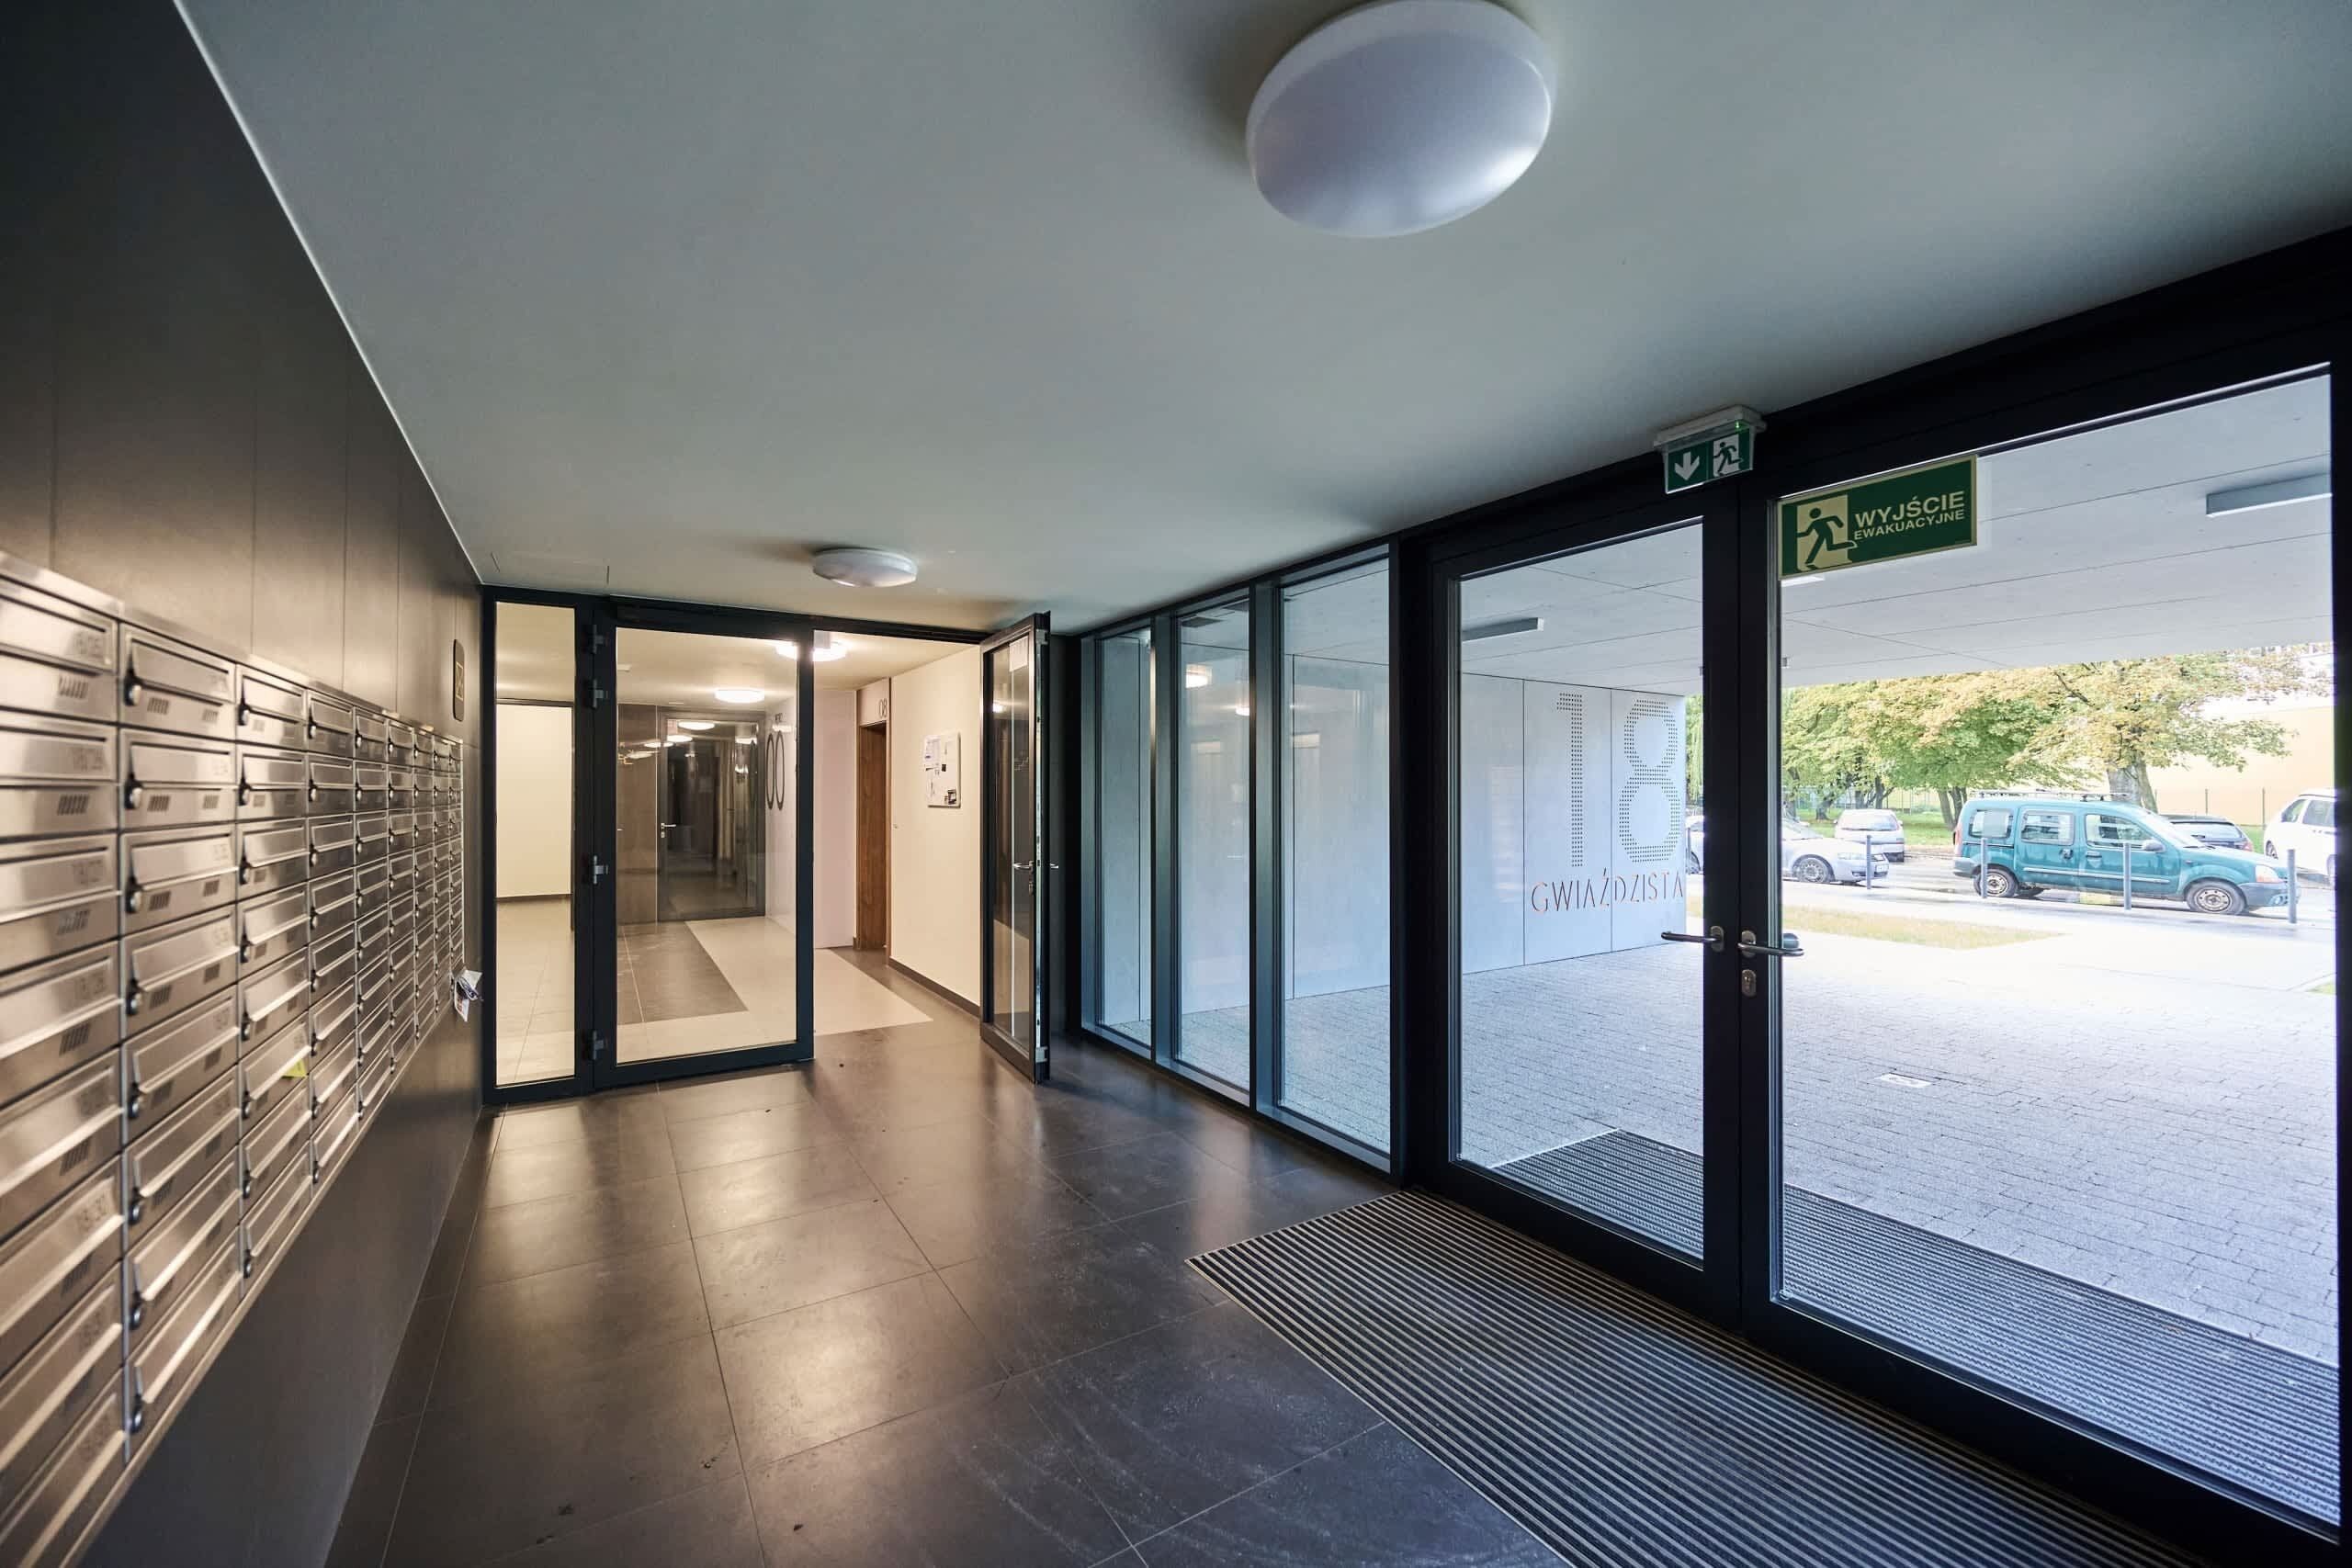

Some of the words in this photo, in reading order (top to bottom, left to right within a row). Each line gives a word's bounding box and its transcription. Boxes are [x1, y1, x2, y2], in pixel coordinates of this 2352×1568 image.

[1854, 509, 1965, 540] EWAKUACYJNE
[1855, 491, 1965, 528] WYJŚCIE
[1556, 692, 1680, 867] 18
[1531, 867, 1683, 912] GWIAŹDZISTA
